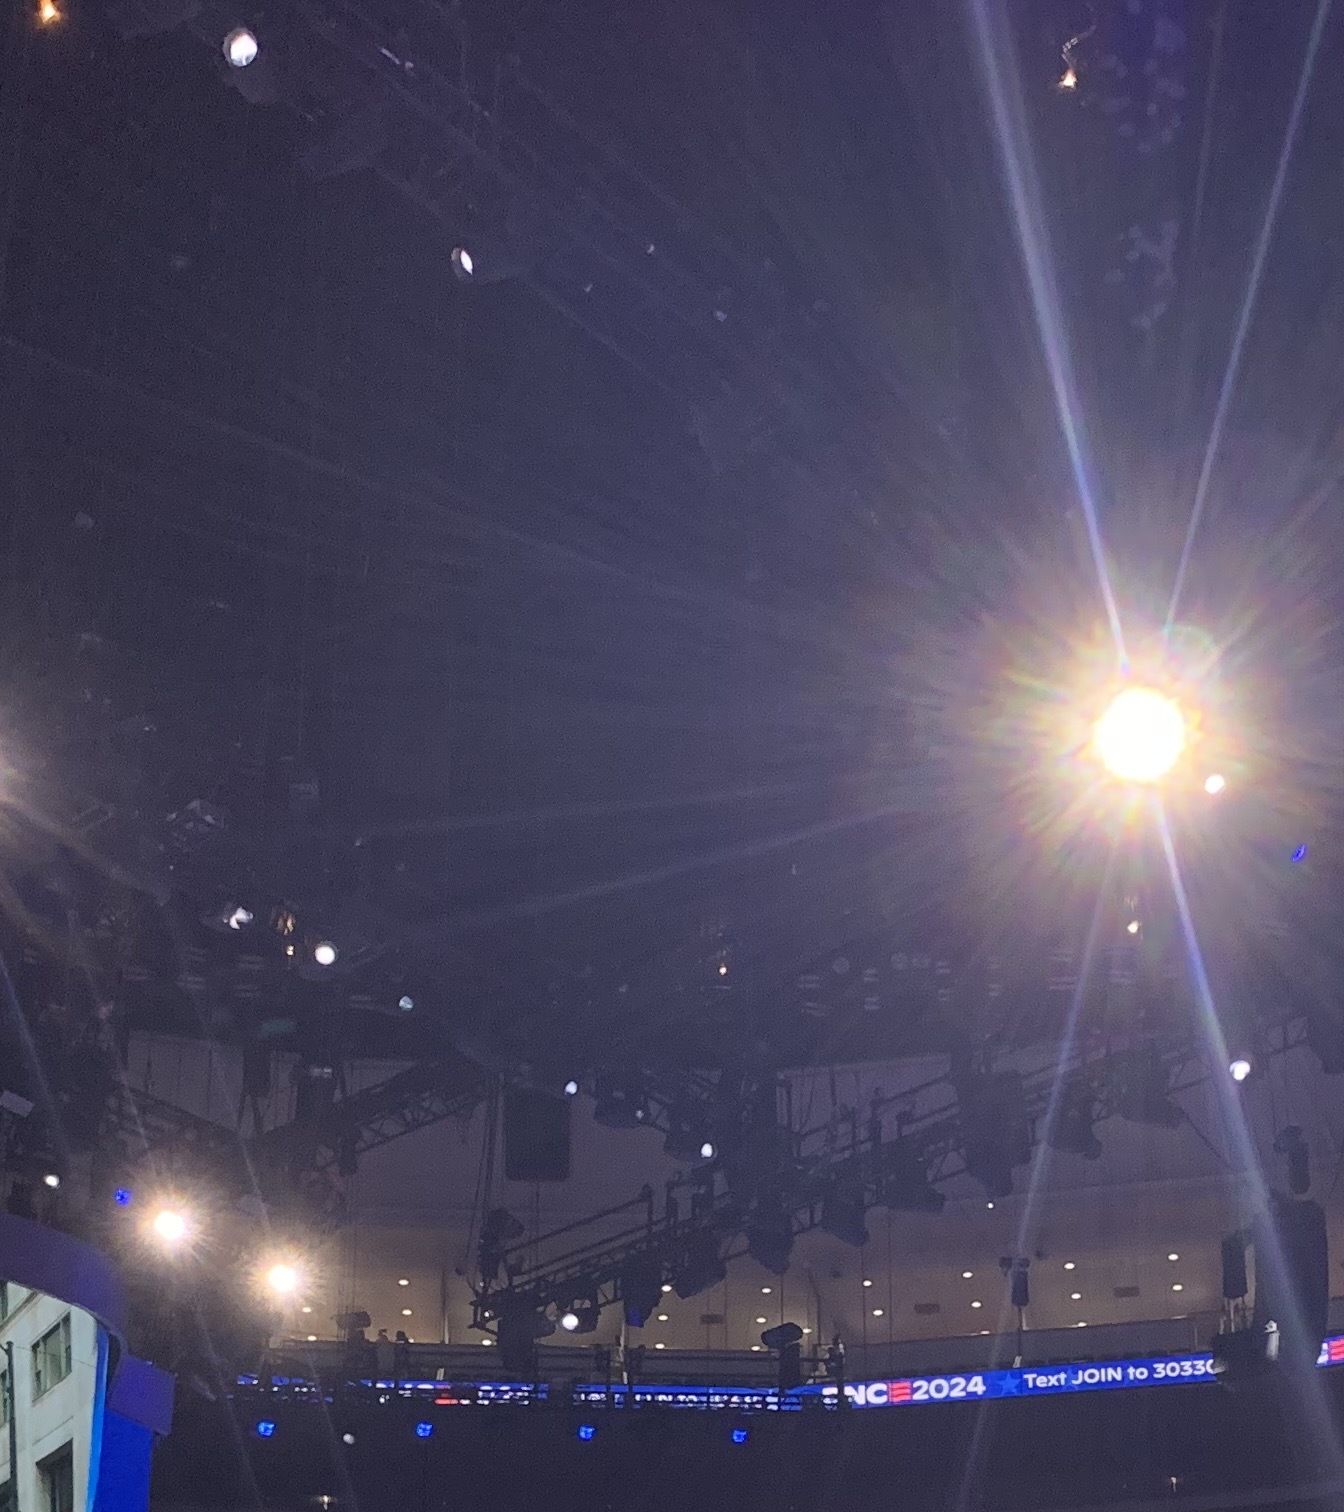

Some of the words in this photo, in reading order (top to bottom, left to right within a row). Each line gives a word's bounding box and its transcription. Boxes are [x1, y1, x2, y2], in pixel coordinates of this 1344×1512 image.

[912, 1375, 986, 1401] 2024
[1024, 1371, 1068, 1391] Text
[1071, 1366, 1124, 1385] JOIN
[1127, 1364, 1149, 1382] to
